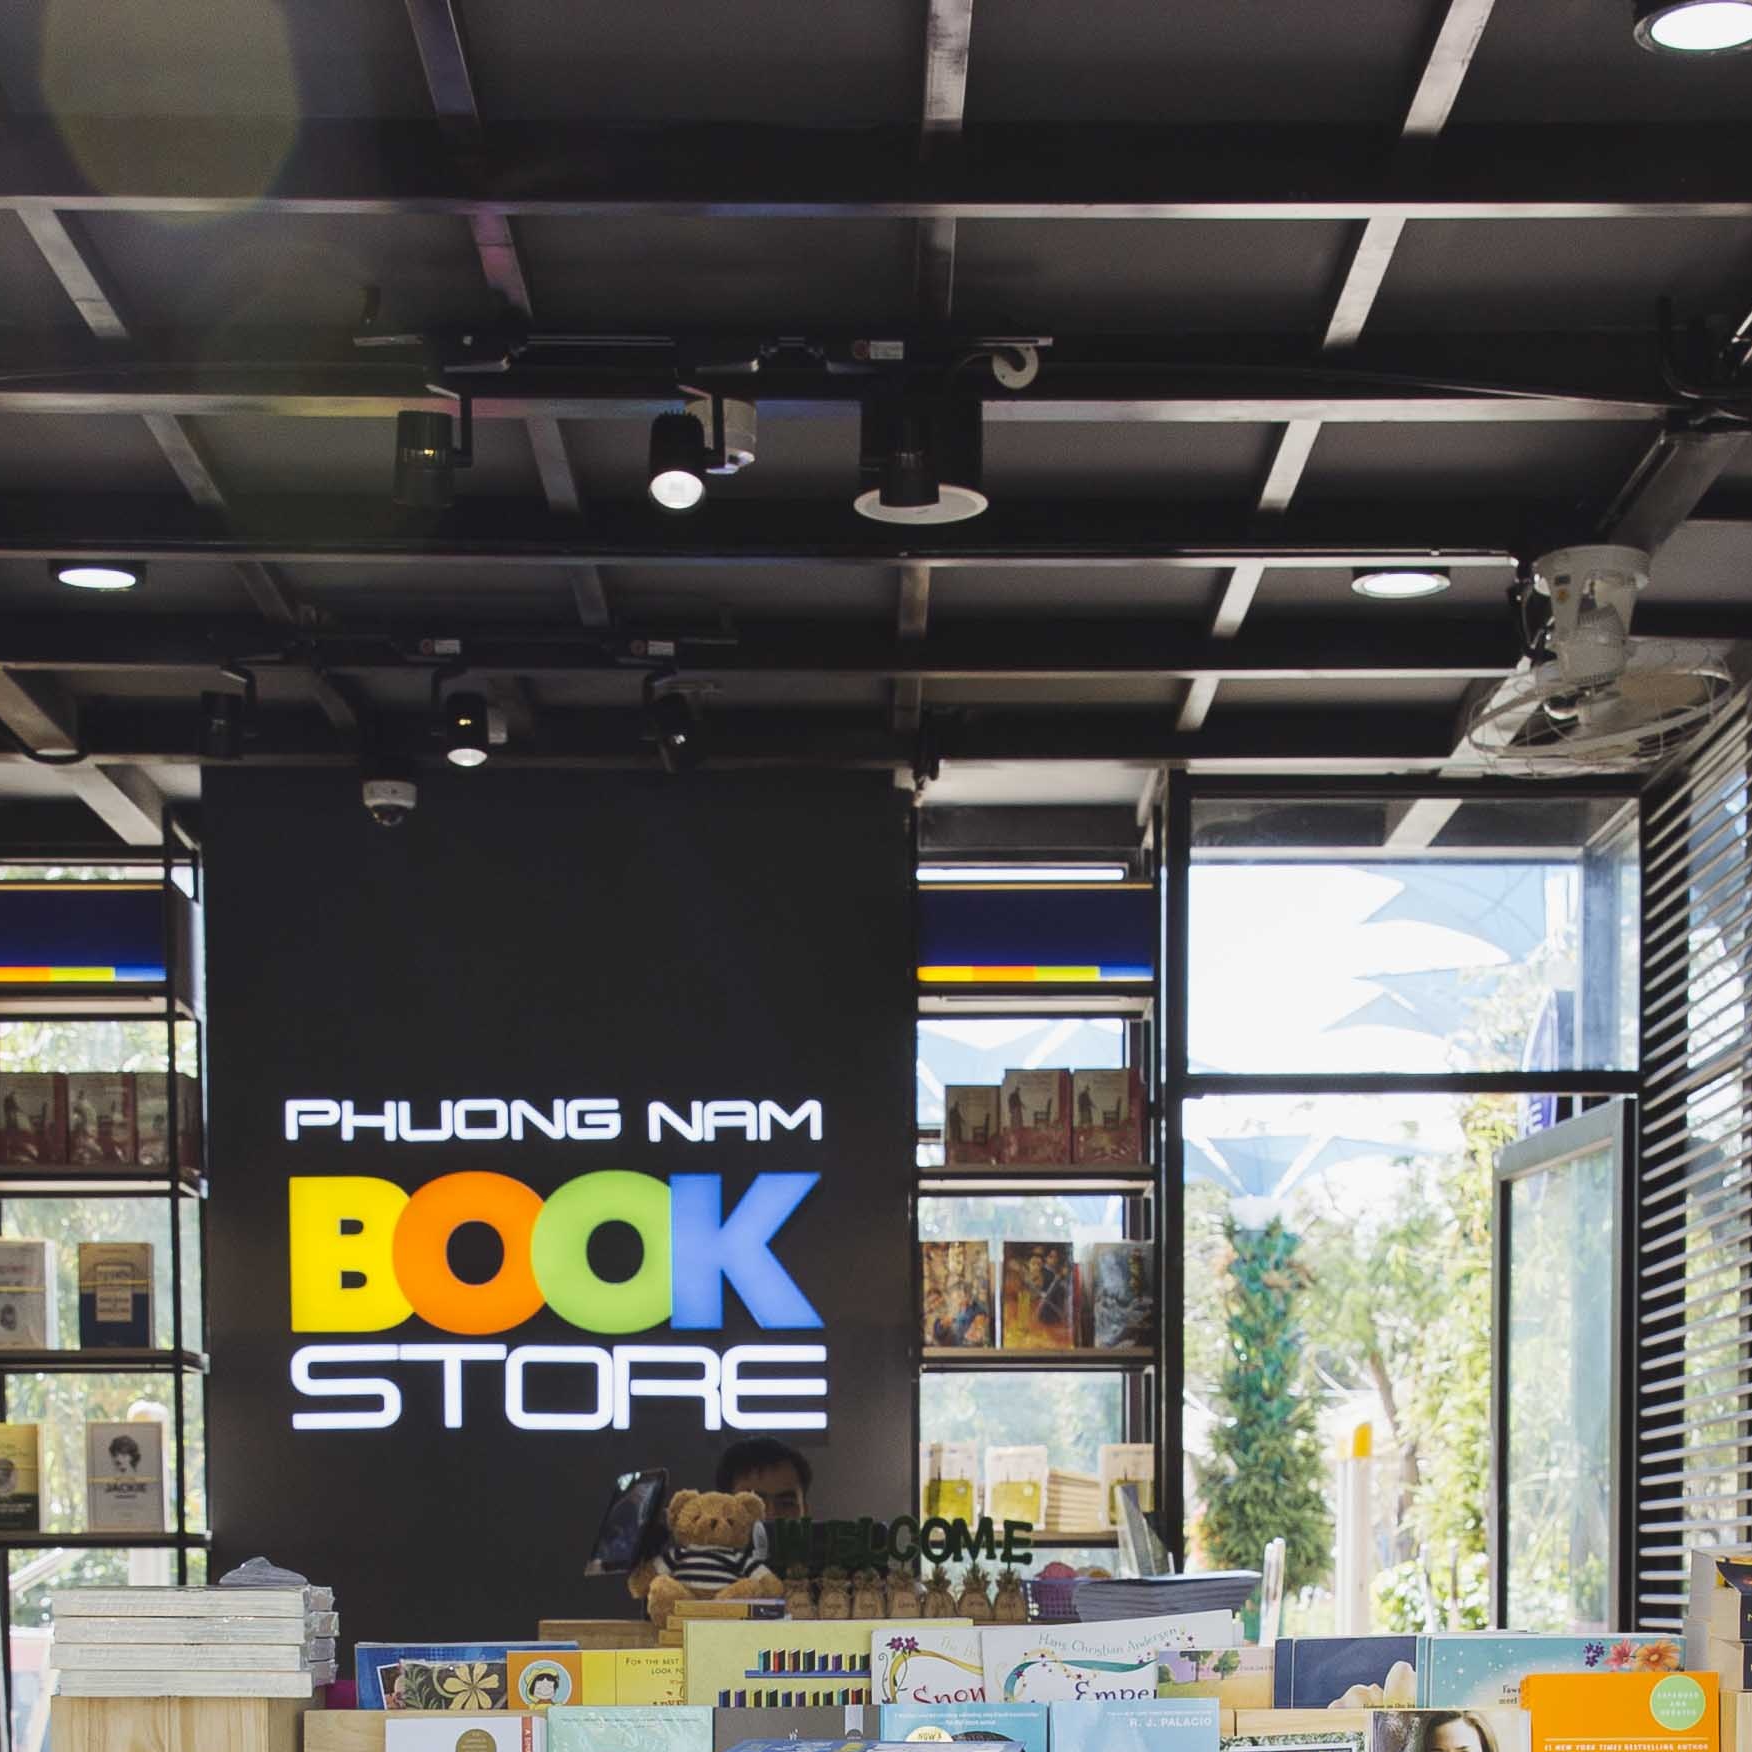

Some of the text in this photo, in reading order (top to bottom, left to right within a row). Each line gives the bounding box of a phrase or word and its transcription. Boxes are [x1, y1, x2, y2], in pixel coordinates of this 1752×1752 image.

[284, 1099, 823, 1142] PHUONG NAM
[289, 1170, 824, 1334] BOOK
[290, 1344, 827, 1430] STORE
[1160, 1717, 1213, 1727] PALACIO
